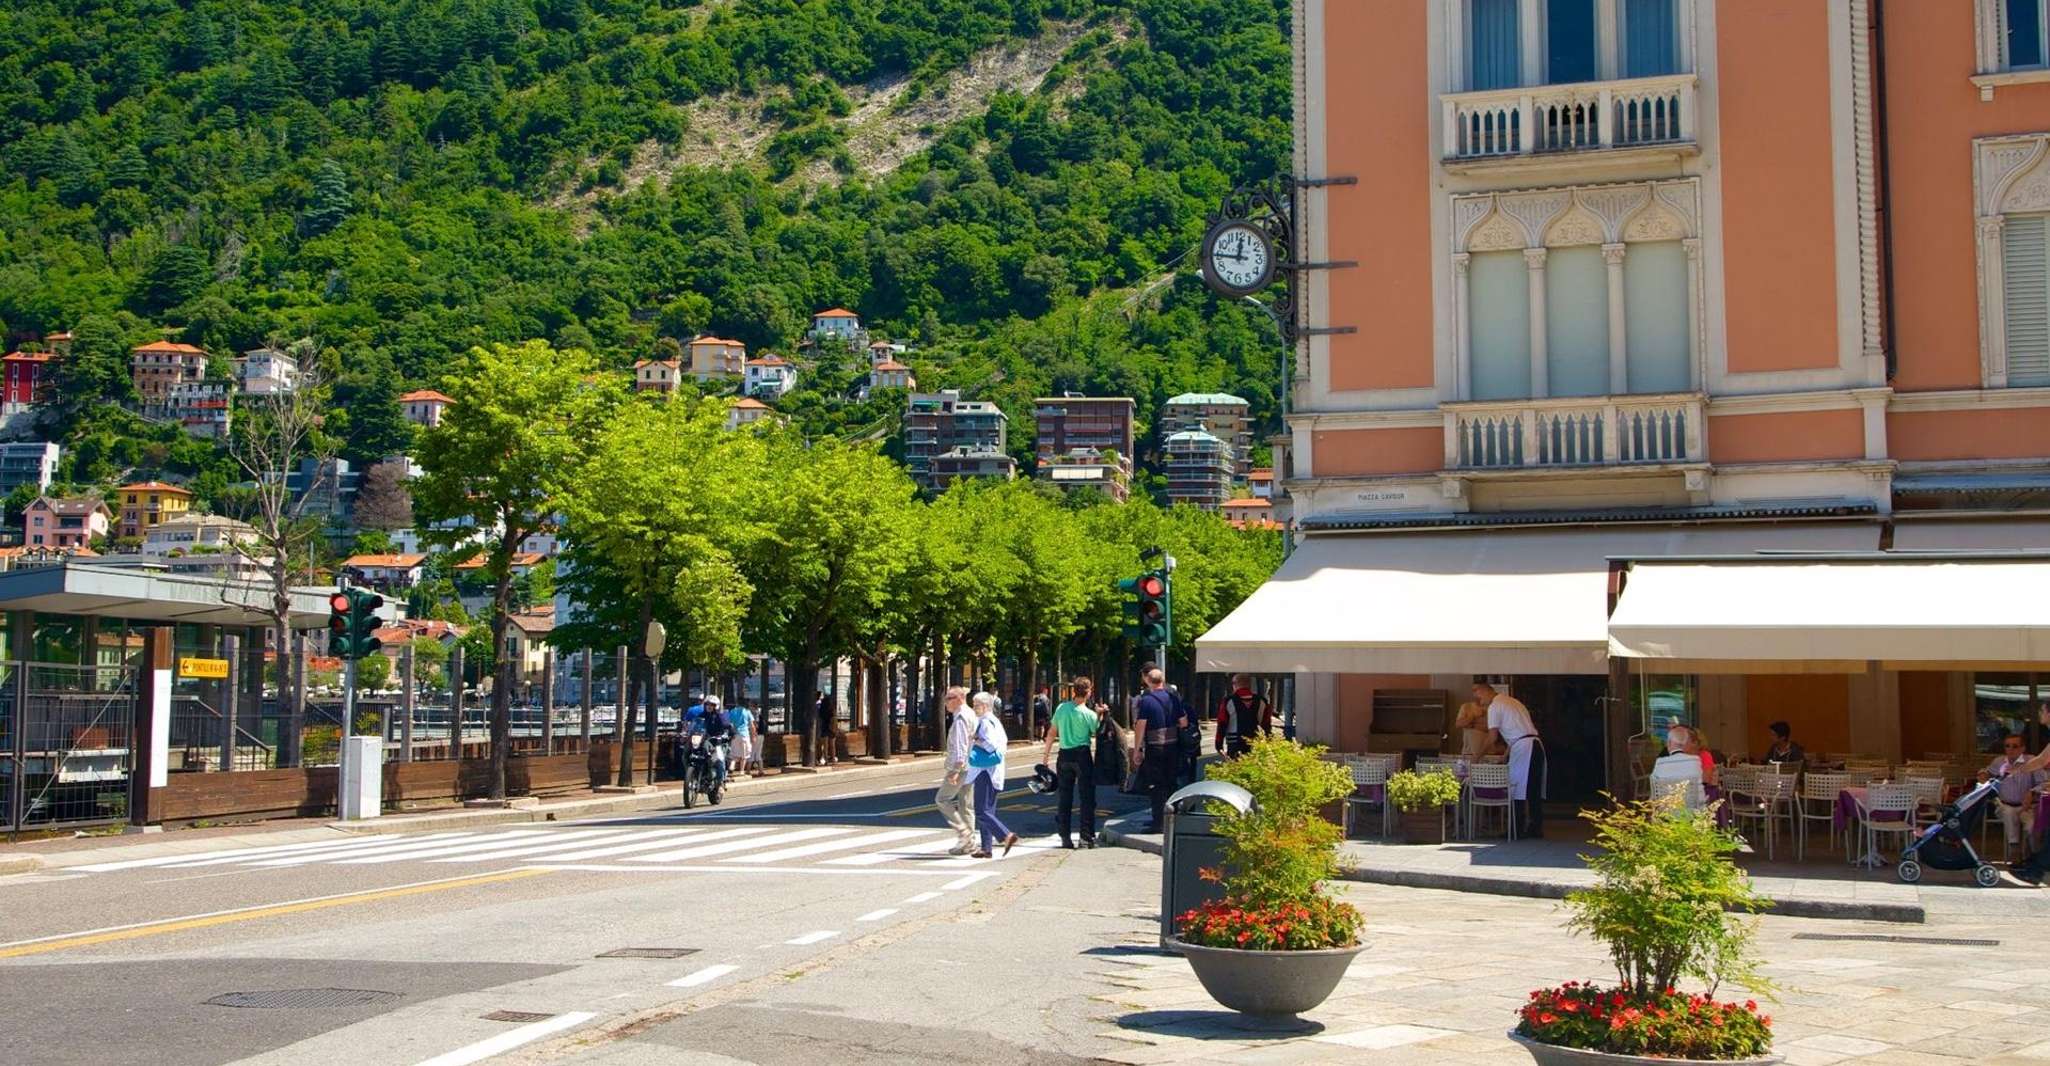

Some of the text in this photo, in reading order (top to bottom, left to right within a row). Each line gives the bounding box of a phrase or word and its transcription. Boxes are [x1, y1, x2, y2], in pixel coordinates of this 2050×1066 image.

[1227, 232, 1234, 245] 11
[1235, 231, 1246, 242] 12
[1247, 235, 1251, 246] 1
[1218, 239, 1228, 250] 10
[1253, 241, 1261, 252] 2
[1255, 253, 1263, 265] 3
[1217, 261, 1226, 272] 8
[1252, 266, 1260, 276] 4
[1226, 270, 1233, 281] 7
[1234, 273, 1242, 284] 6
[1244, 272, 1252, 283] 5
[1358, 493, 1379, 501] PIAZZA
